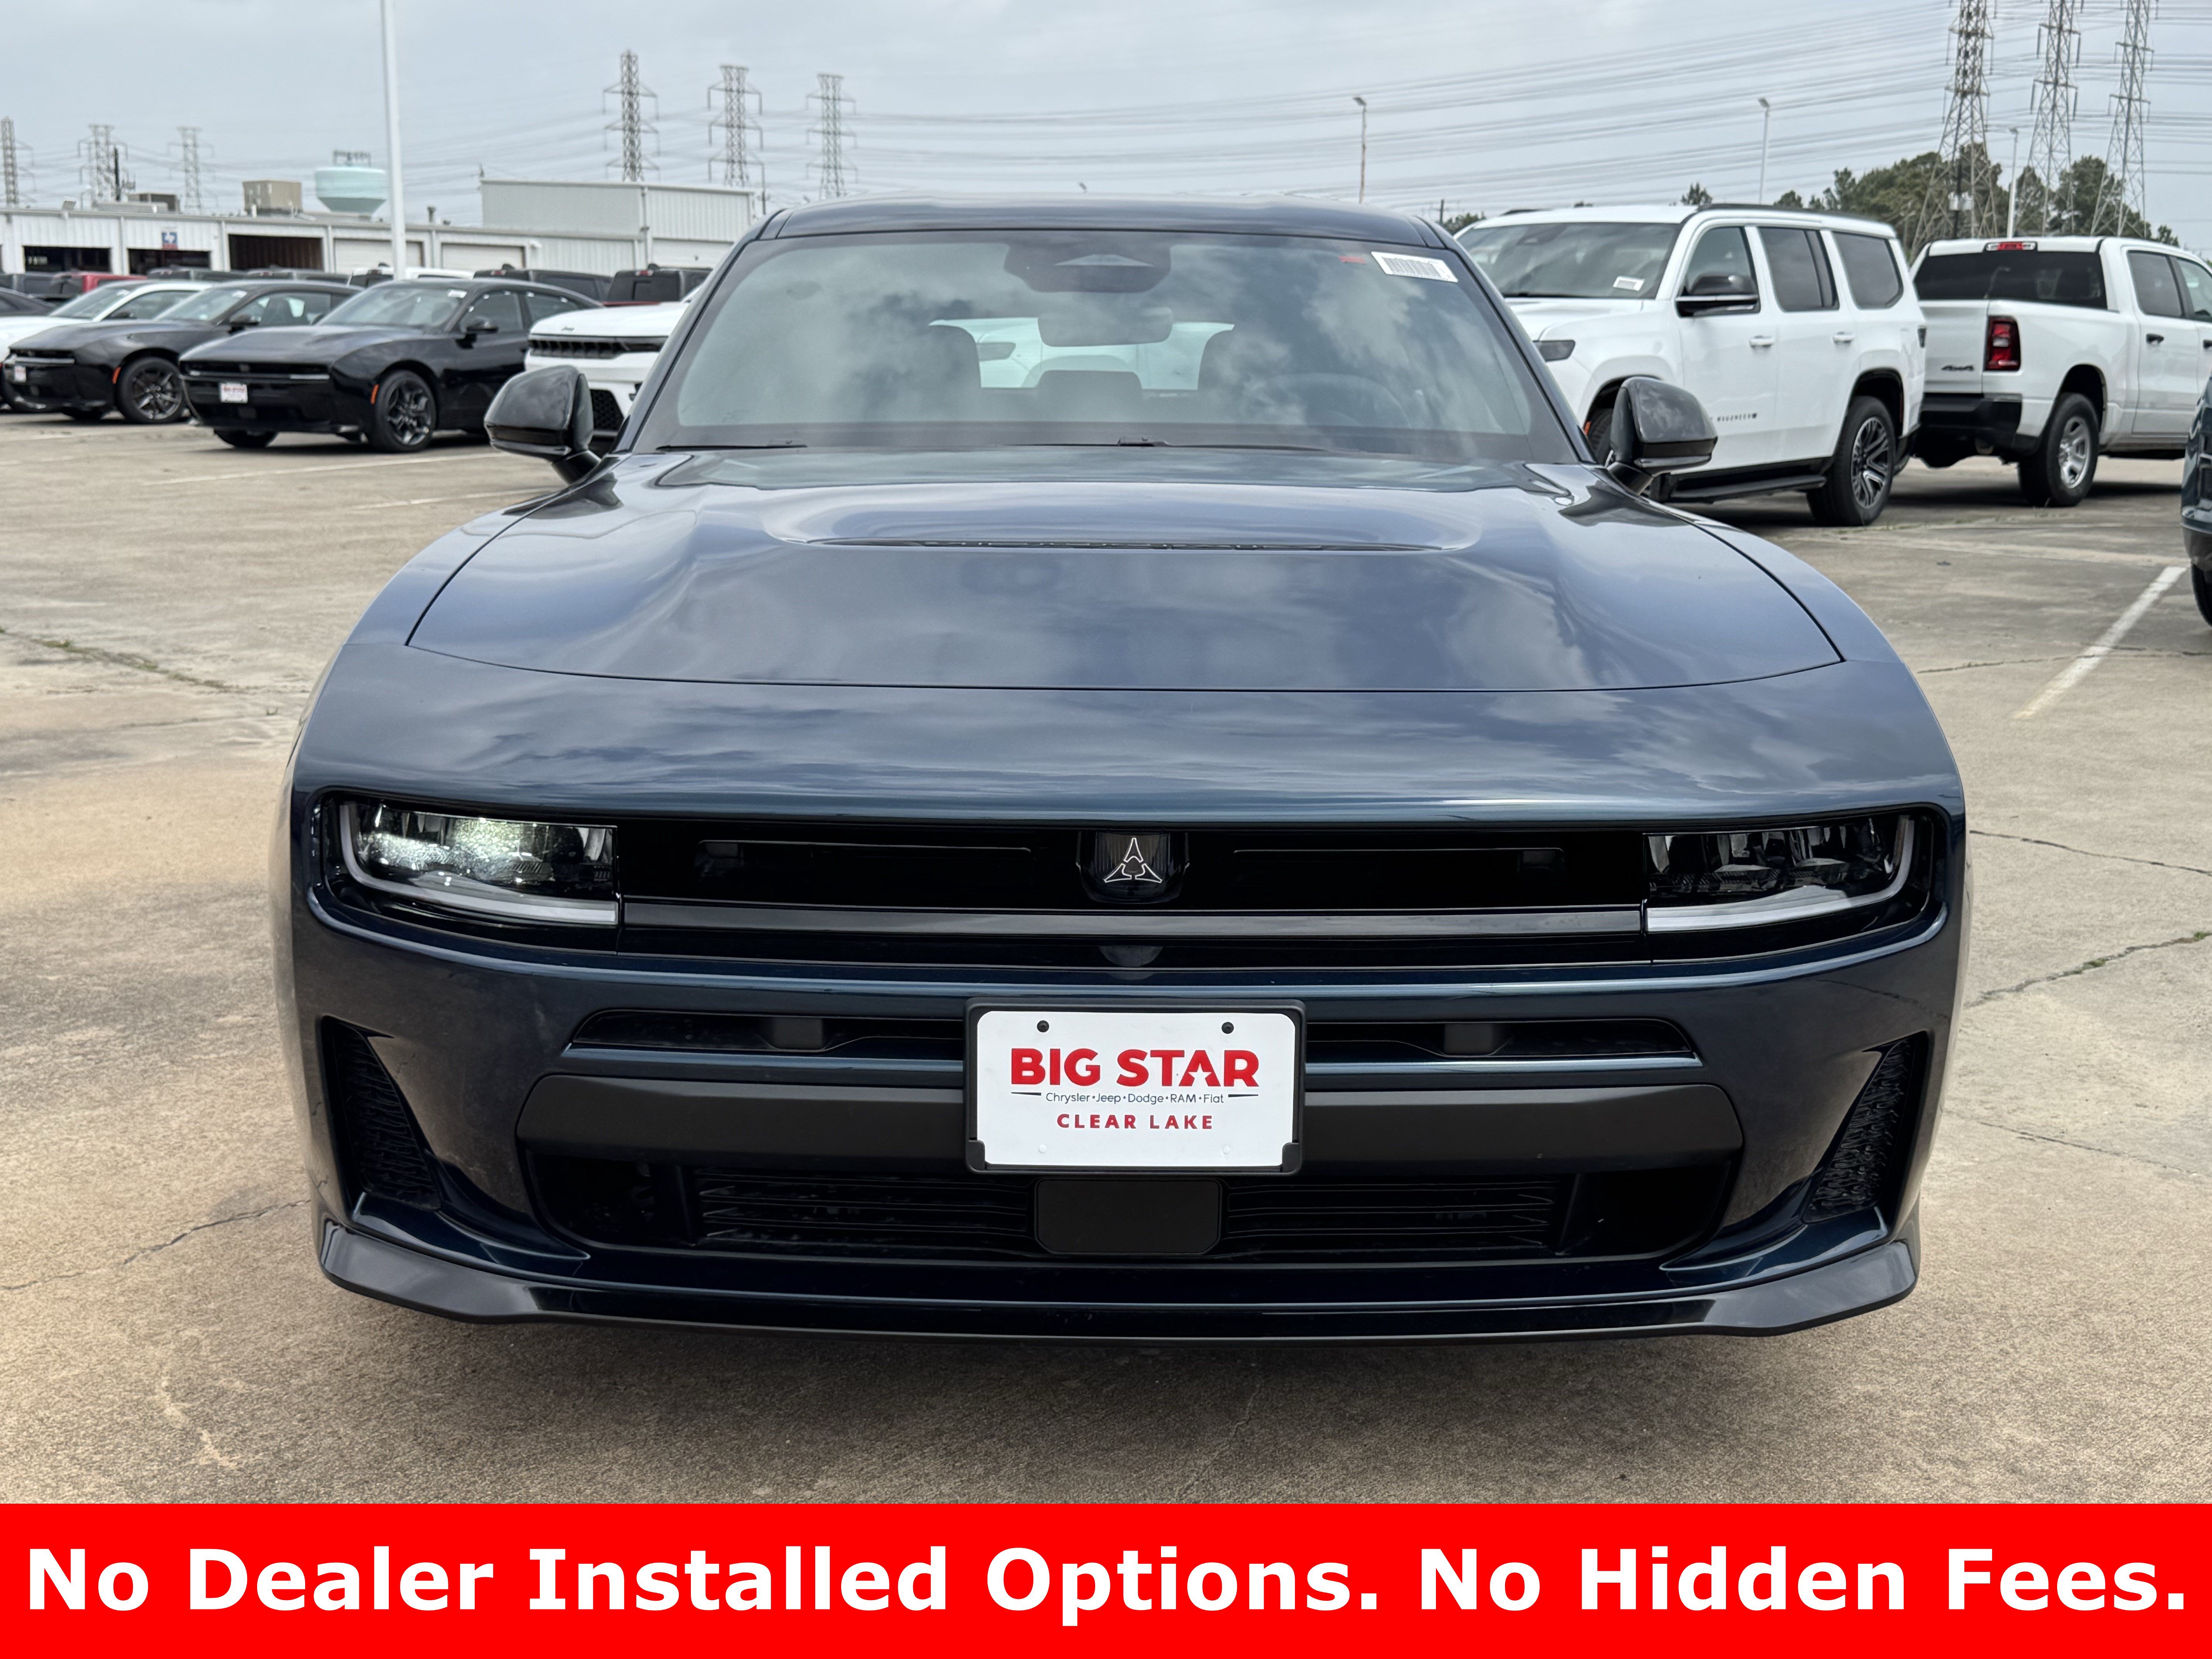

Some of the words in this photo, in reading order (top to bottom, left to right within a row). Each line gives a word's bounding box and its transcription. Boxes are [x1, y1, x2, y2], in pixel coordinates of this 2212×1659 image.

[1011, 1048, 1101, 1085] BIG
[1116, 1049, 1260, 1087] STAR
[1046, 1092, 1091, 1104] Chrysler
[1096, 1093, 1121, 1104] Jeep
[1128, 1093, 1164, 1105] Dodge
[1170, 1094, 1196, 1103] RAM
[1204, 1094, 1224, 1103] Fiat
[1057, 1114, 1137, 1129] CLEAR
[1150, 1115, 1213, 1130] LAKE
